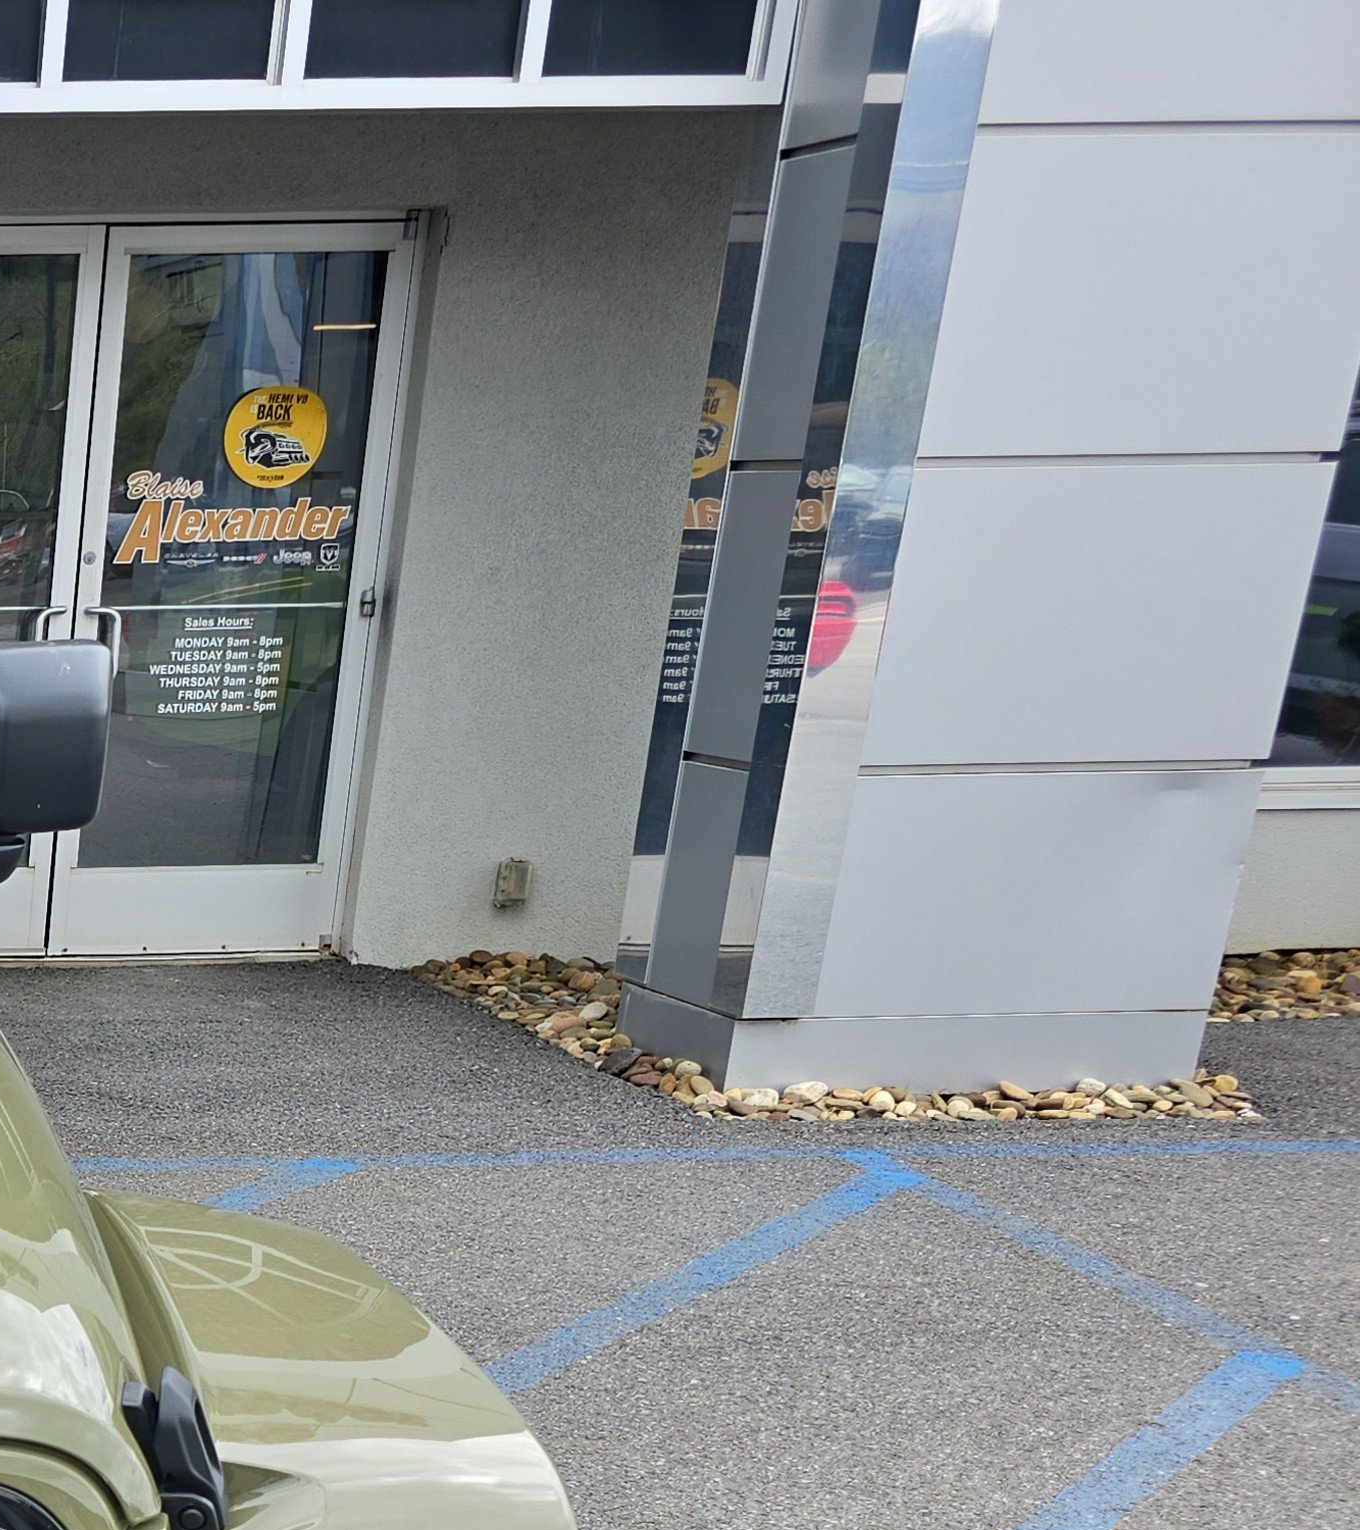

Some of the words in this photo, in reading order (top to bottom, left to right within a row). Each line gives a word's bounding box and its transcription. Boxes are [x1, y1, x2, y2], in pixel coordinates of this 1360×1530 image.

[268, 393, 293, 404] HEMI
[256, 404, 293, 421] BACK
[127, 470, 204, 500] Blaise
[113, 497, 352, 565] Alexander
[272, 548, 312, 566] Jeep
[184, 617, 214, 628] Sales
[217, 616, 254, 627] Hours:
[174, 637, 225, 649] MONDAY
[227, 637, 249, 647] 9am
[259, 636, 283, 647] 8pm
[170, 650, 223, 662] TUESDAY
[225, 650, 248, 660] 9am
[257, 649, 282, 660] 8pm
[149, 663, 225, 675] WEDNESDAY
[224, 663, 247, 673] 9am
[256, 662, 280, 674] 5pm
[159, 676, 220, 688] THURSDAY
[222, 676, 245, 686] 9am
[255, 675, 279, 686] 8pm
[178, 690, 219, 701] FRIDAY
[221, 689, 244, 699] 9am
[254, 688, 278, 700] 8pm
[157, 703, 218, 714] SATURDAY
[220, 702, 243, 712] 9am
[252, 701, 276, 713] 5pm
